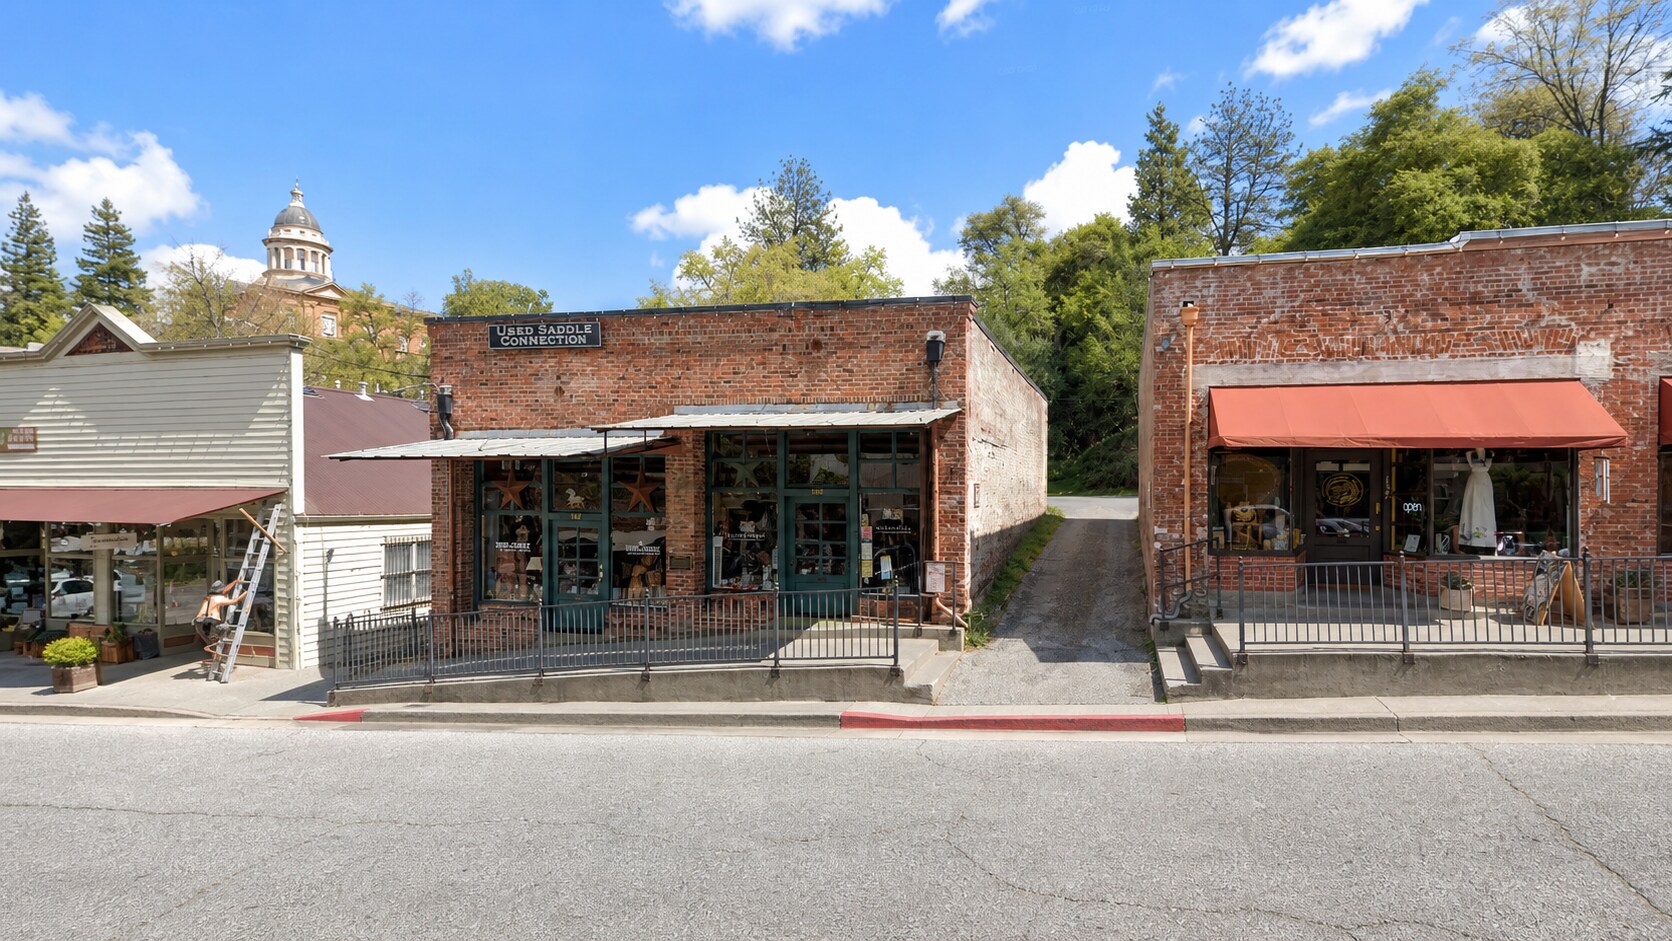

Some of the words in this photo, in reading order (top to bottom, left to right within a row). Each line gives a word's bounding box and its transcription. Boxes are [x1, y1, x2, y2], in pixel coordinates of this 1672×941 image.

[496, 325, 534, 336] USED
[538, 324, 592, 335] SADDLE
[500, 335, 587, 346] CONNECTION
